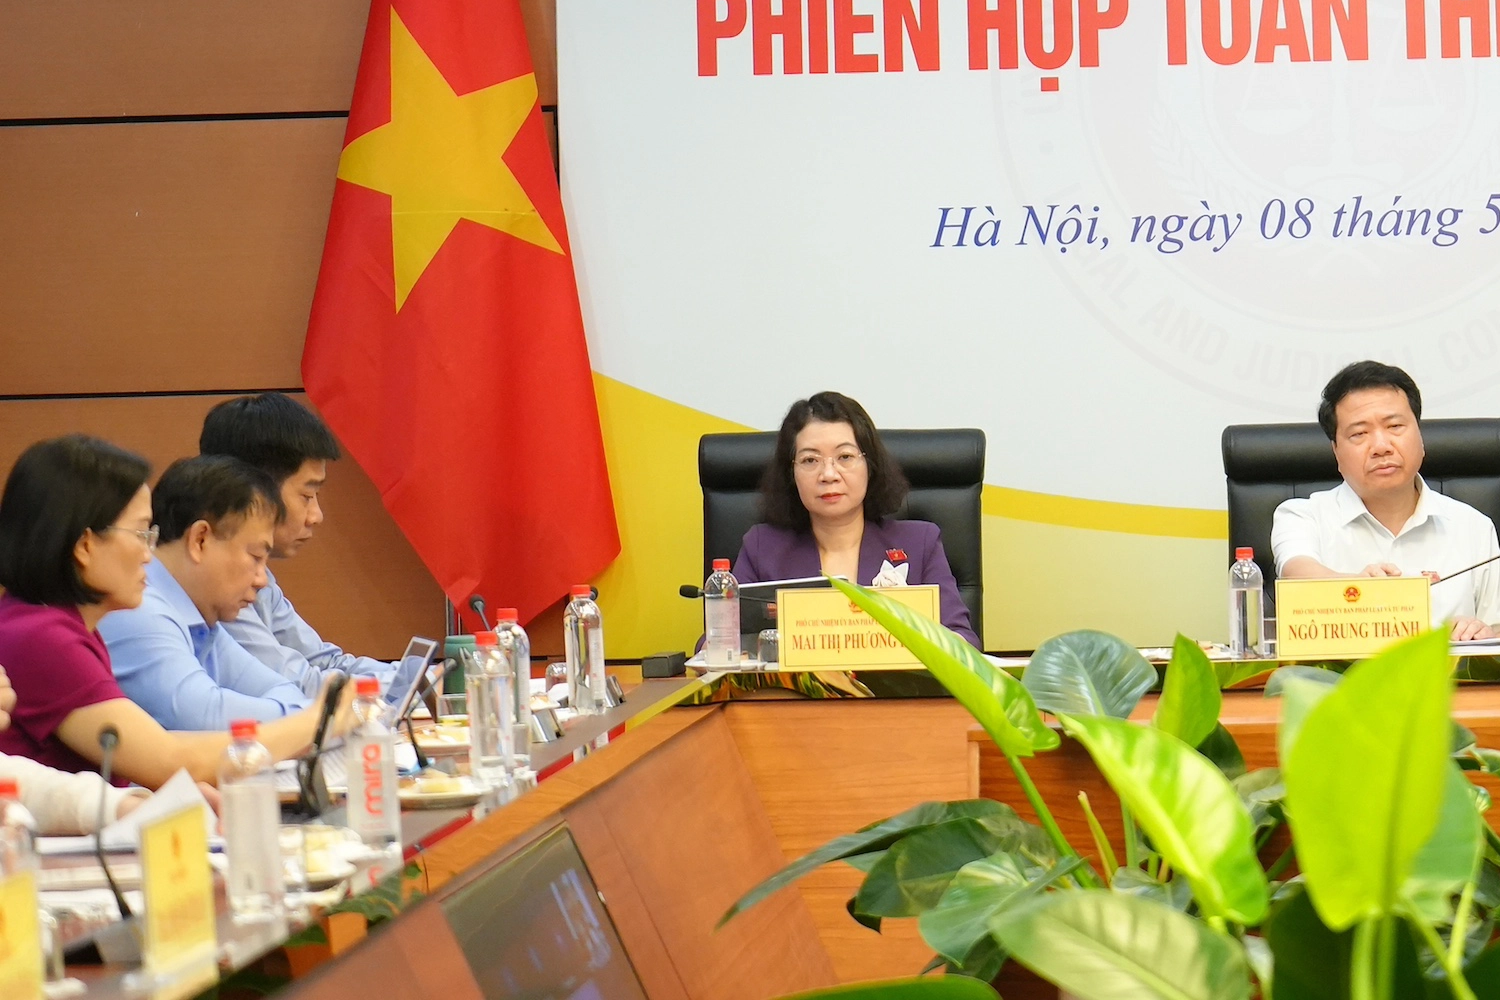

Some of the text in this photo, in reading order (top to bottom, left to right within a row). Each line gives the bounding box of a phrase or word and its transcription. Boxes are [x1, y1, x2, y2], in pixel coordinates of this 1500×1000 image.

[929, 205, 1001, 249] Hà
[1015, 203, 1109, 255] Nội,
[1130, 200, 1243, 255] ngày
[1259, 197, 1315, 240] 08
[1331, 195, 1463, 248] tháng
[1288, 616, 1420, 641] NGÔ TRUNG THÀNH
[792, 634, 816, 651] MAI
[819, 633, 840, 654] THỊ
[844, 630, 897, 649] PHƯƠNG
